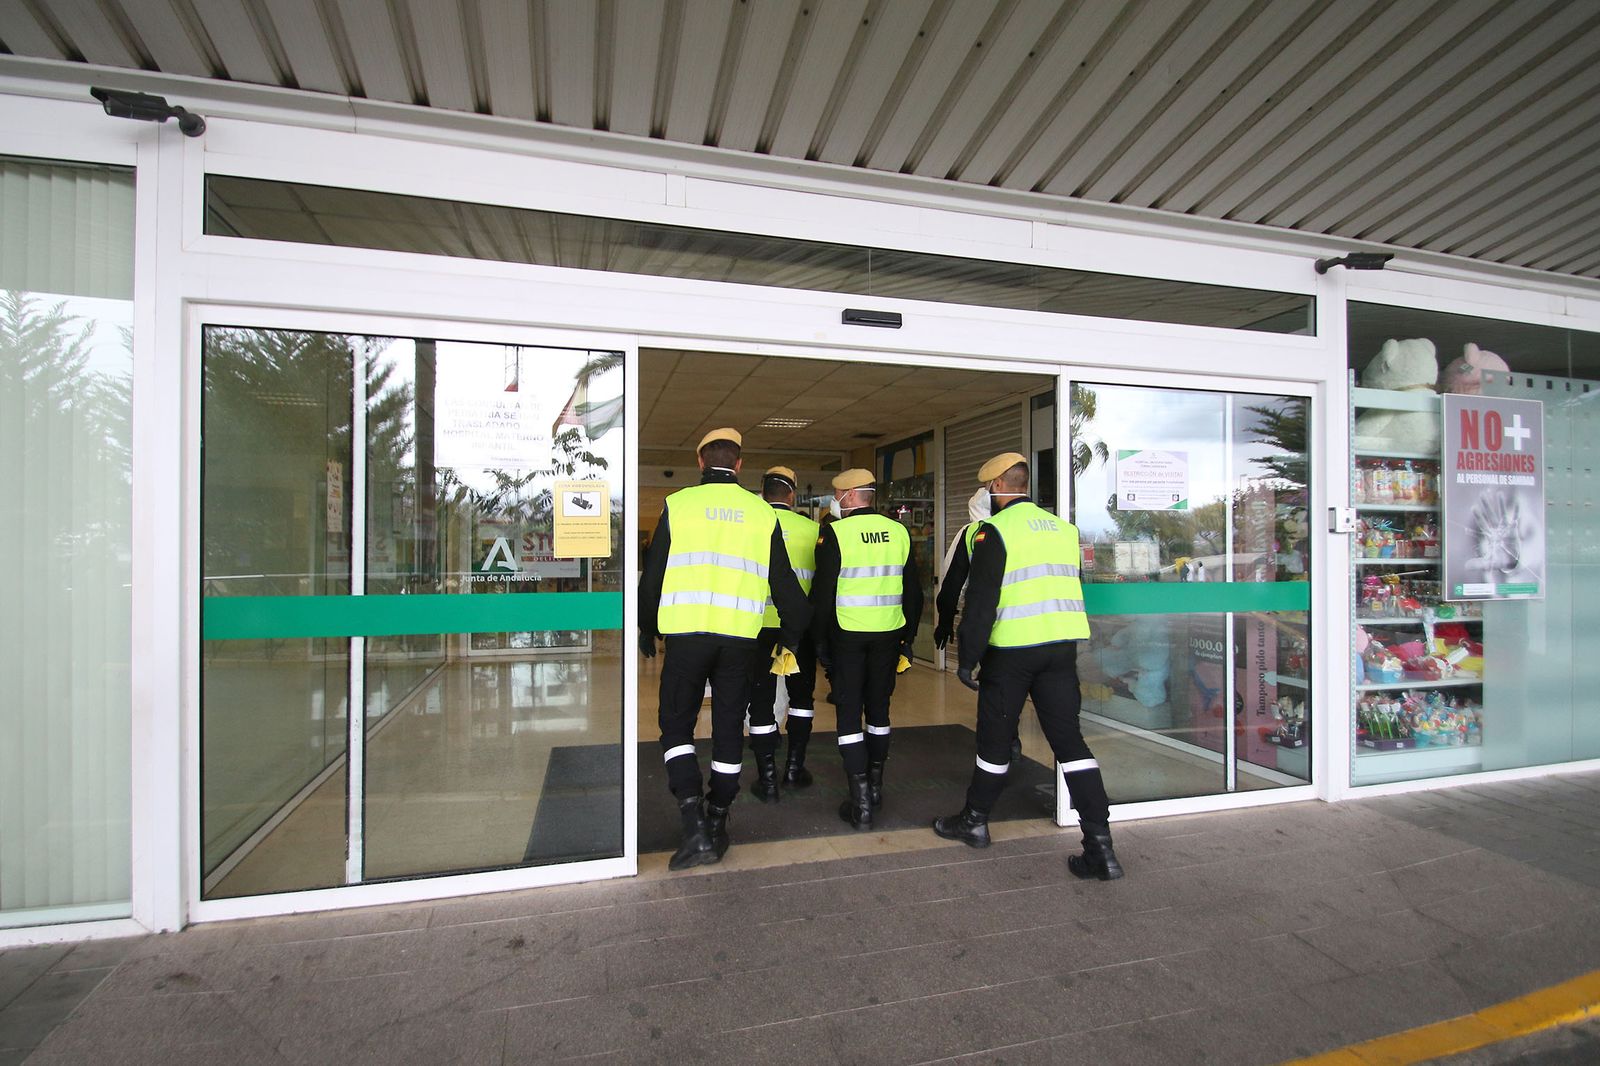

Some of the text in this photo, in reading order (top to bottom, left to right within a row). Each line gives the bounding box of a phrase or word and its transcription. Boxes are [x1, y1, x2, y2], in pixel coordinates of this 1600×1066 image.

[503, 411, 519, 420] SE
[1456, 451, 1535, 473] AGRESIONES
[1456, 473, 1465, 483] AL
[1466, 474, 1499, 485] PERSONAL
[705, 507, 745, 523] UME
[1027, 518, 1059, 532] UME
[860, 531, 890, 544] UME
[461, 572, 542, 584] Junta de Andalucía
[1256, 621, 1268, 717] Tampoco pido tanto
